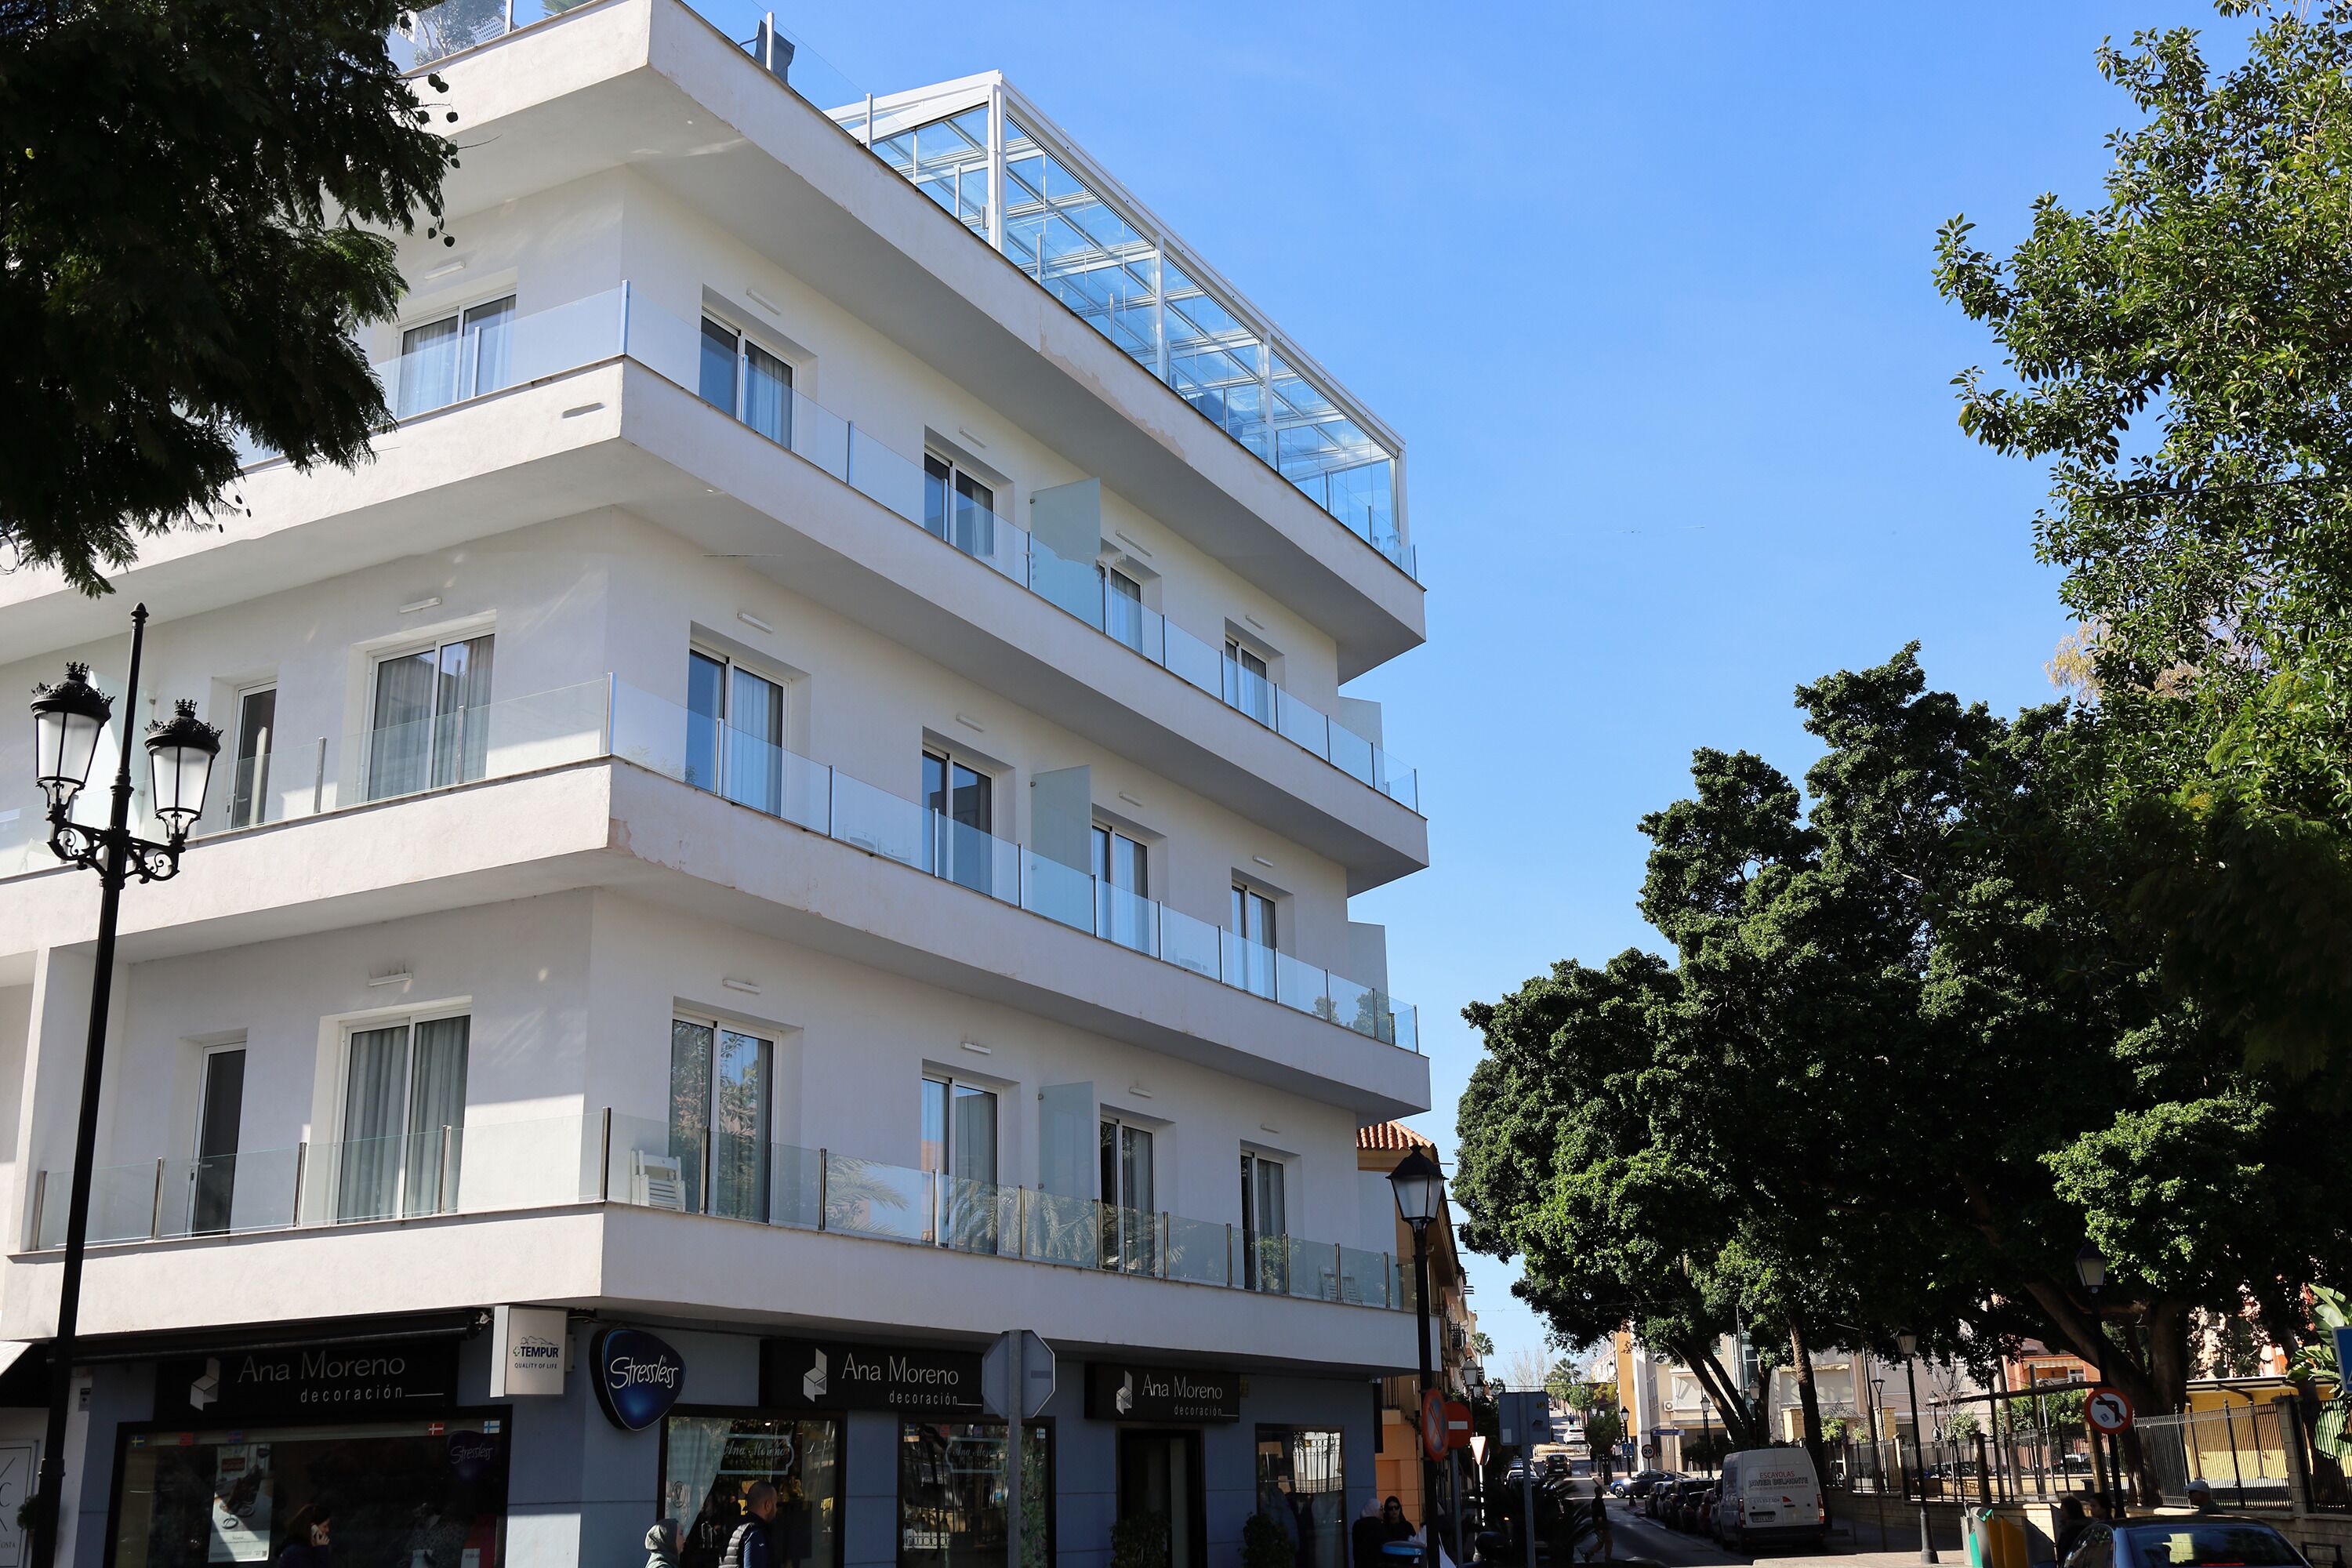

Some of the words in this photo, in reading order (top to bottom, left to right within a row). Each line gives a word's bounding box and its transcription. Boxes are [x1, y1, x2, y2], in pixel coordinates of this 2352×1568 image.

[521, 1346, 558, 1358] TEMPUR
[238, 1355, 290, 1382] Ana
[301, 1349, 405, 1379] Moreno
[610, 1355, 679, 1389] Stressless
[842, 1352, 881, 1381] Ana
[888, 1356, 959, 1385] Moreno
[300, 1385, 402, 1403] decoración
[1142, 1374, 1169, 1397] Ana
[1174, 1375, 1222, 1399] Moreno
[889, 1390, 957, 1406] decoración
[1174, 1405, 1222, 1416] decoración
[450, 1443, 493, 1464] Stressless
